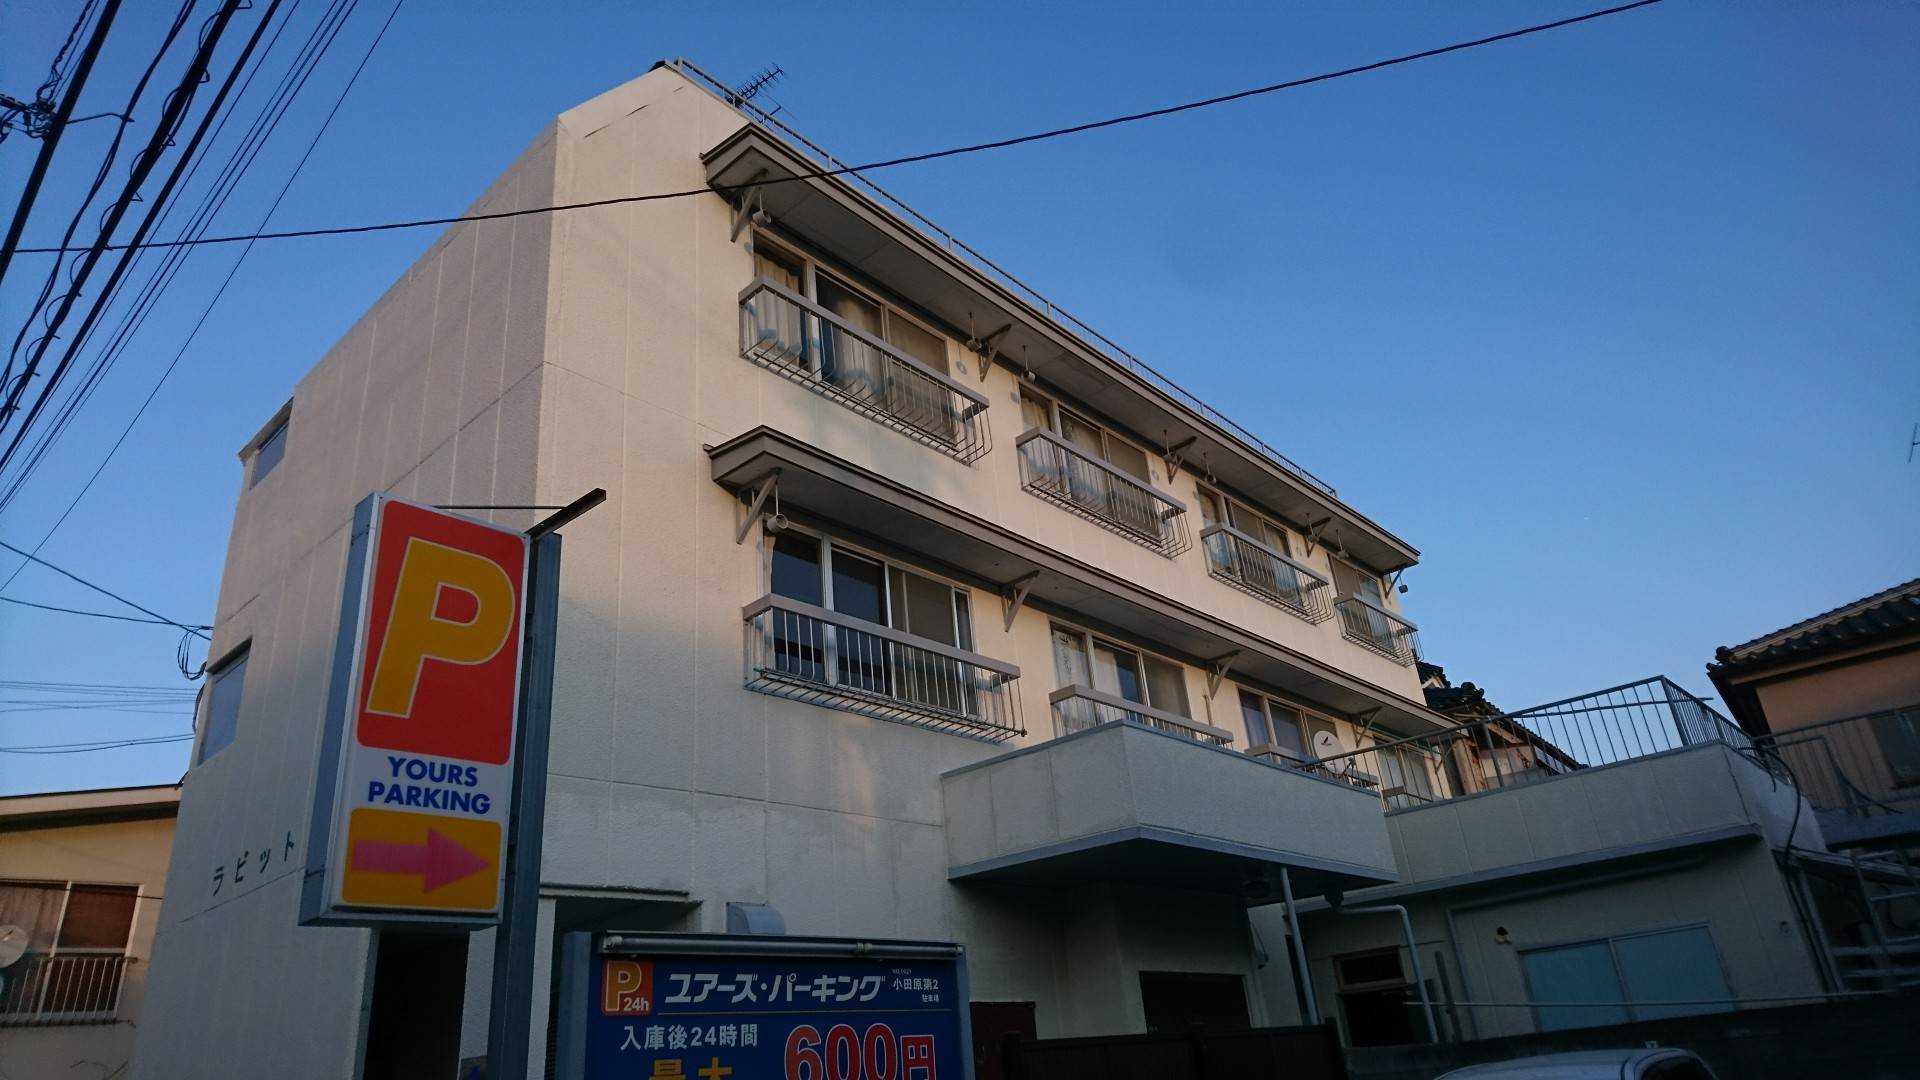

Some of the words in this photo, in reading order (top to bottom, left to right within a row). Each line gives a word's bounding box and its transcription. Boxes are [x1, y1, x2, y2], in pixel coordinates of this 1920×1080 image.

[365, 536, 516, 719] P
[388, 756, 478, 787] YOURS
[367, 781, 491, 815] PARKING
[605, 960, 642, 1012] P
[665, 973, 886, 1004] ユアーズ・パーキング
[893, 977, 939, 991] 小田原第2
[623, 997, 650, 1012] 24h
[620, 1023, 758, 1051] 入庫後24時間
[784, 1022, 937, 1080] 600円
